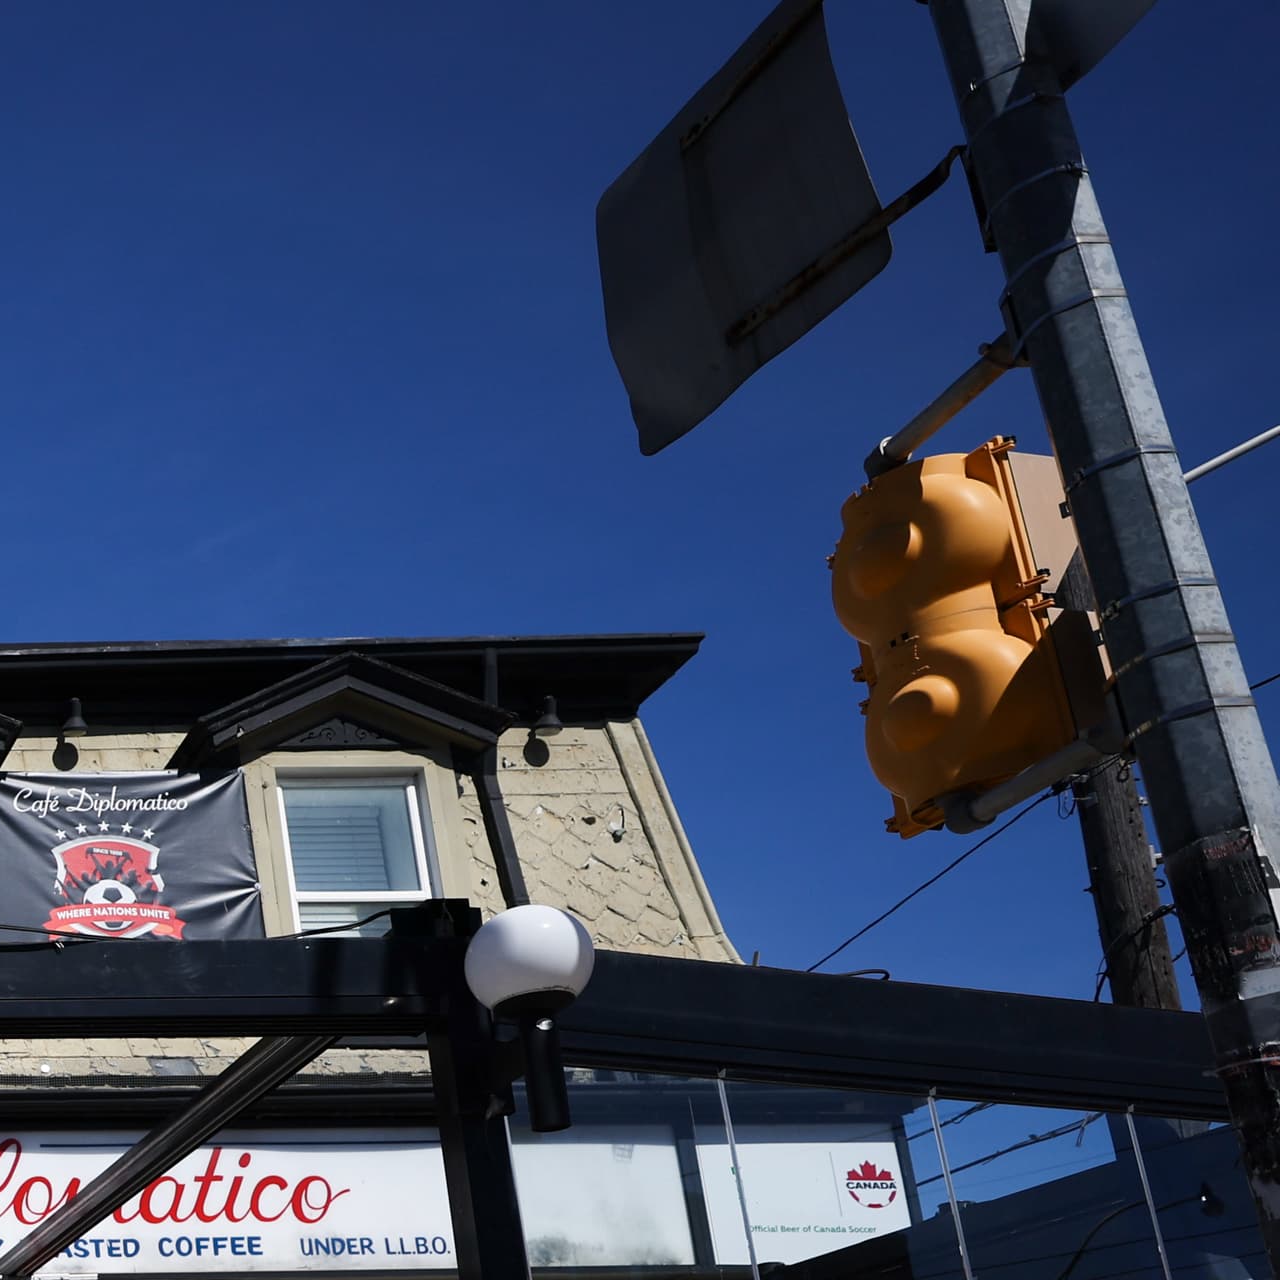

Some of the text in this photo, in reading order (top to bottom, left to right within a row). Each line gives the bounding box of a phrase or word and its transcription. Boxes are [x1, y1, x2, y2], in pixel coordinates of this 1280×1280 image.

[13, 784, 188, 818] Café Diplomatico
[56, 907, 170, 920] WHERE NATIONS UNITE
[846, 1181, 897, 1190] CANADA
[780, 1224, 800, 1233] Beer
[802, 1224, 811, 1233] of
[813, 1224, 846, 1233] Canada
[848, 1225, 877, 1233] Soccer
[158, 1236, 263, 1257] COFFEE
[300, 1237, 376, 1256] UNDER
